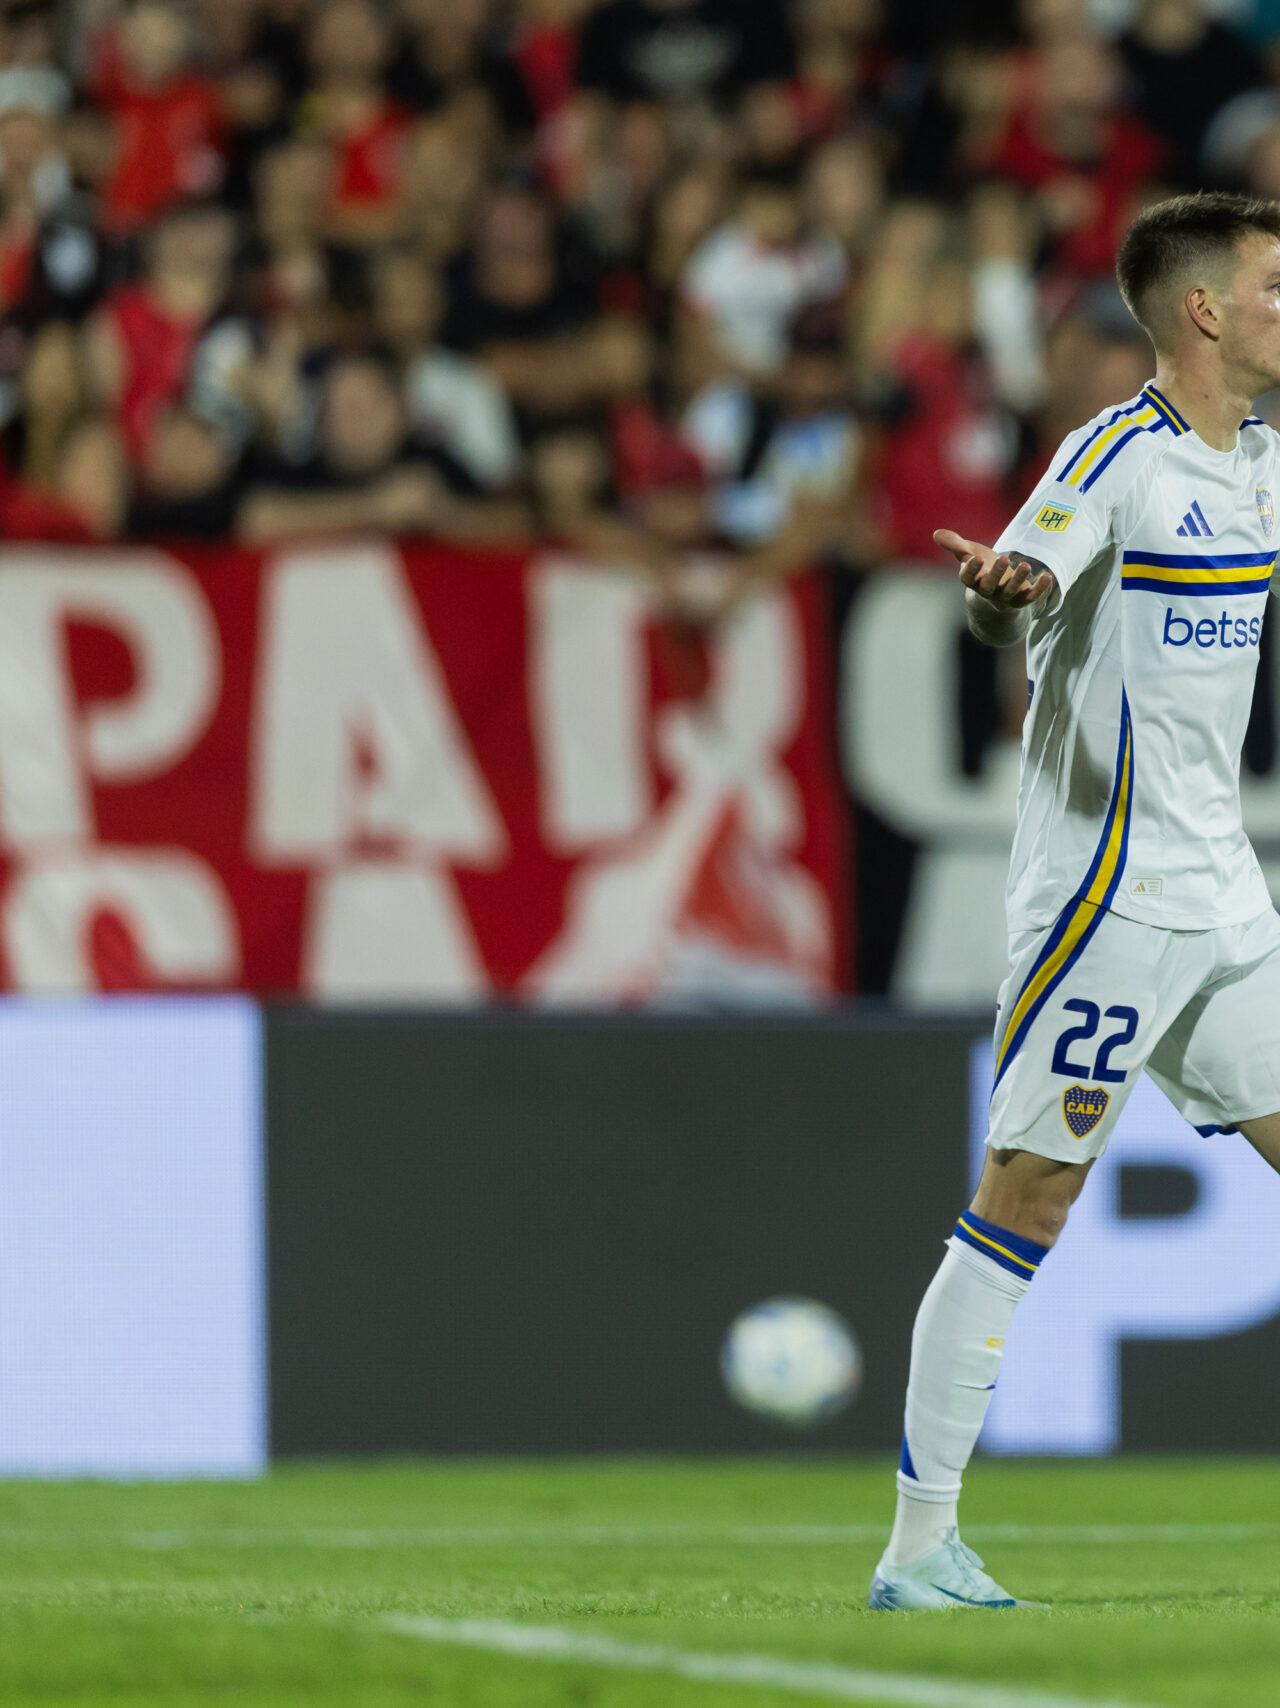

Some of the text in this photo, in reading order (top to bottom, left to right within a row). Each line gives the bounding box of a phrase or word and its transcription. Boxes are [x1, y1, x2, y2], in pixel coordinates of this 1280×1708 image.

[1163, 607, 1264, 648] betss
[1051, 998, 1139, 1083] 22
[1066, 1101, 1103, 1116] CABJ
